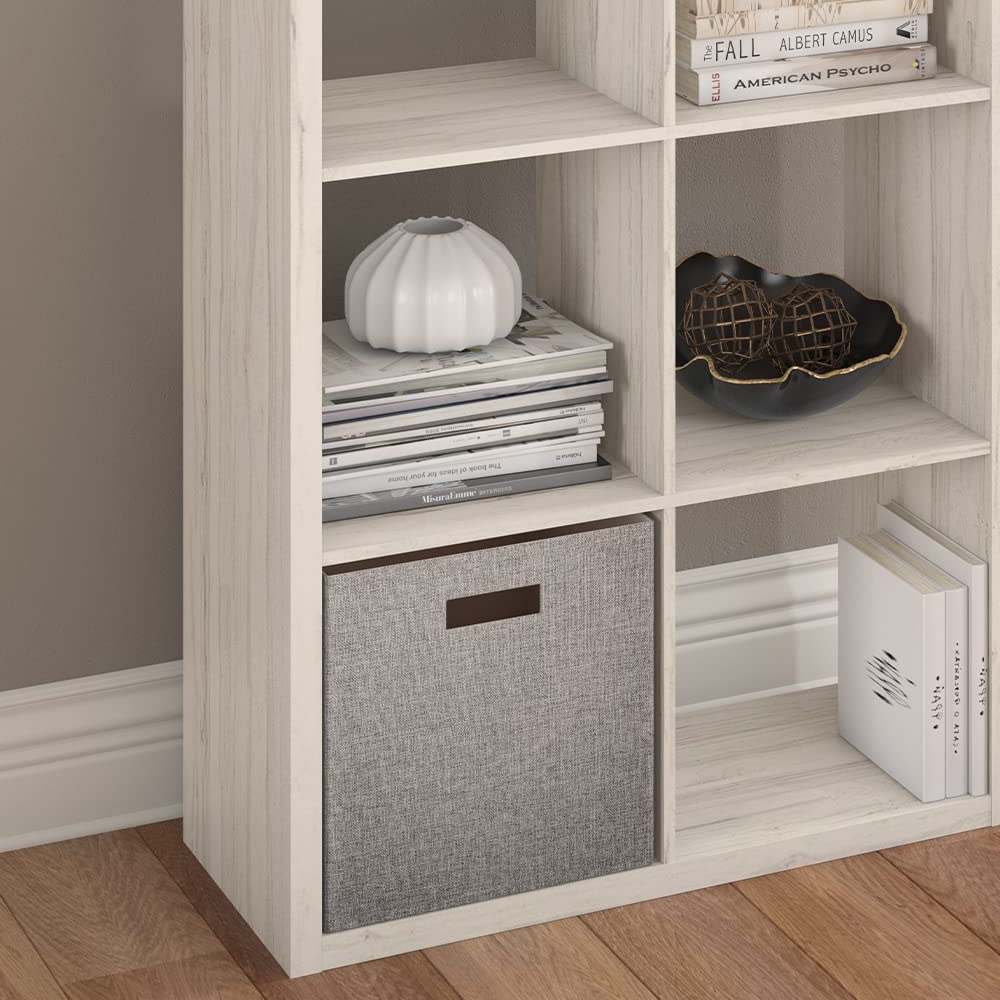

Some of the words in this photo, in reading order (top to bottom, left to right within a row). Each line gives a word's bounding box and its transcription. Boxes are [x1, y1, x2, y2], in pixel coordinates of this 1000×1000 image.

[779, 32, 828, 52] ALBERT
[832, 27, 874, 46] CAMUS
[704, 45, 712, 62] The
[715, 38, 761, 62] FALL
[733, 71, 822, 90] AMERICAN
[826, 63, 892, 78] PSYCHO
[711, 72, 721, 102] ELLIS
[459, 467, 467, 475] of
[469, 464, 487, 474] book
[488, 462, 502, 470] The
[409, 471, 426, 481] your
[427, 470, 438, 481] for
[439, 468, 459, 478] ideas
[387, 475, 408, 484] home
